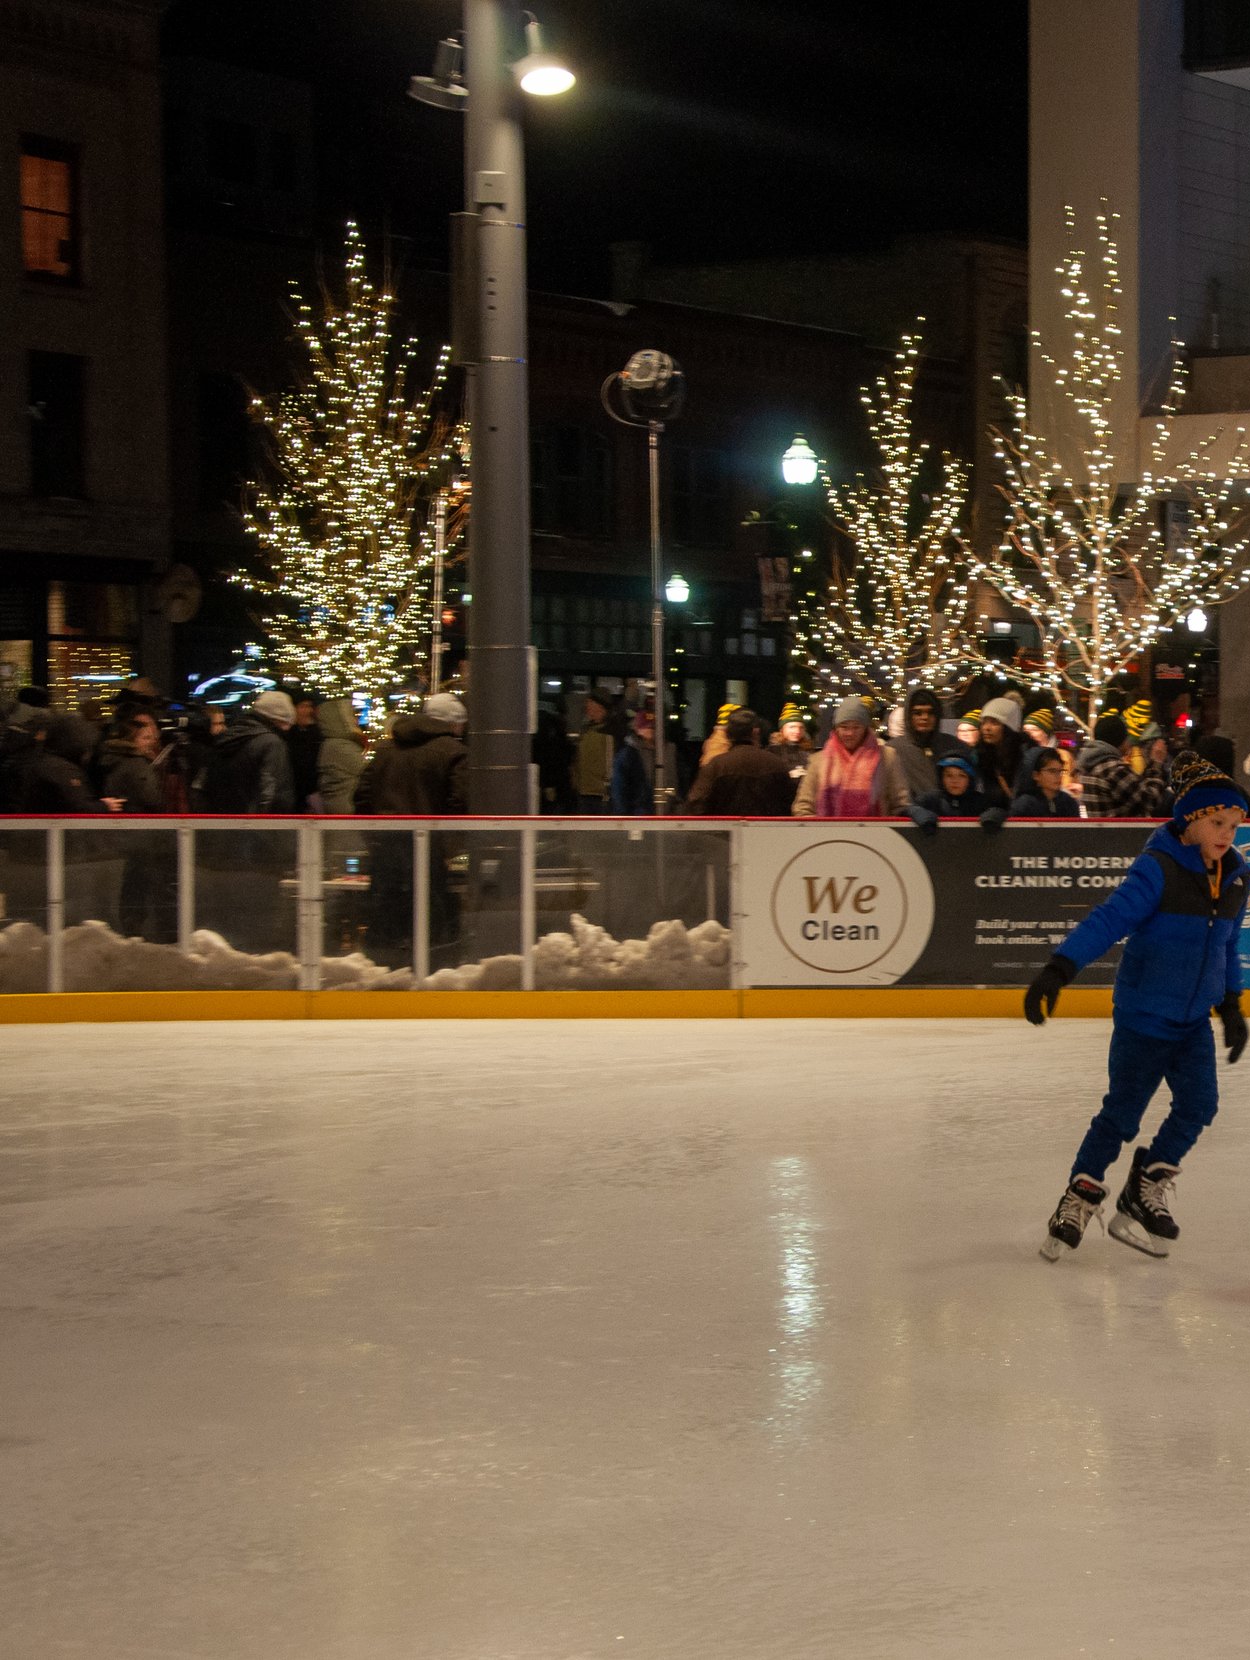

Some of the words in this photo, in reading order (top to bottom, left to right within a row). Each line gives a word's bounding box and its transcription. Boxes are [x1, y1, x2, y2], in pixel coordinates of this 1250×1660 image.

[1010, 856, 1049, 869] THE
[1053, 856, 1136, 869] MODERN
[975, 875, 1073, 888] CLEANING
[802, 876, 879, 914] We
[802, 920, 880, 940] Clean
[975, 919, 1009, 929] Build
[1008, 921, 1039, 931] your
[975, 934, 1006, 944] book
